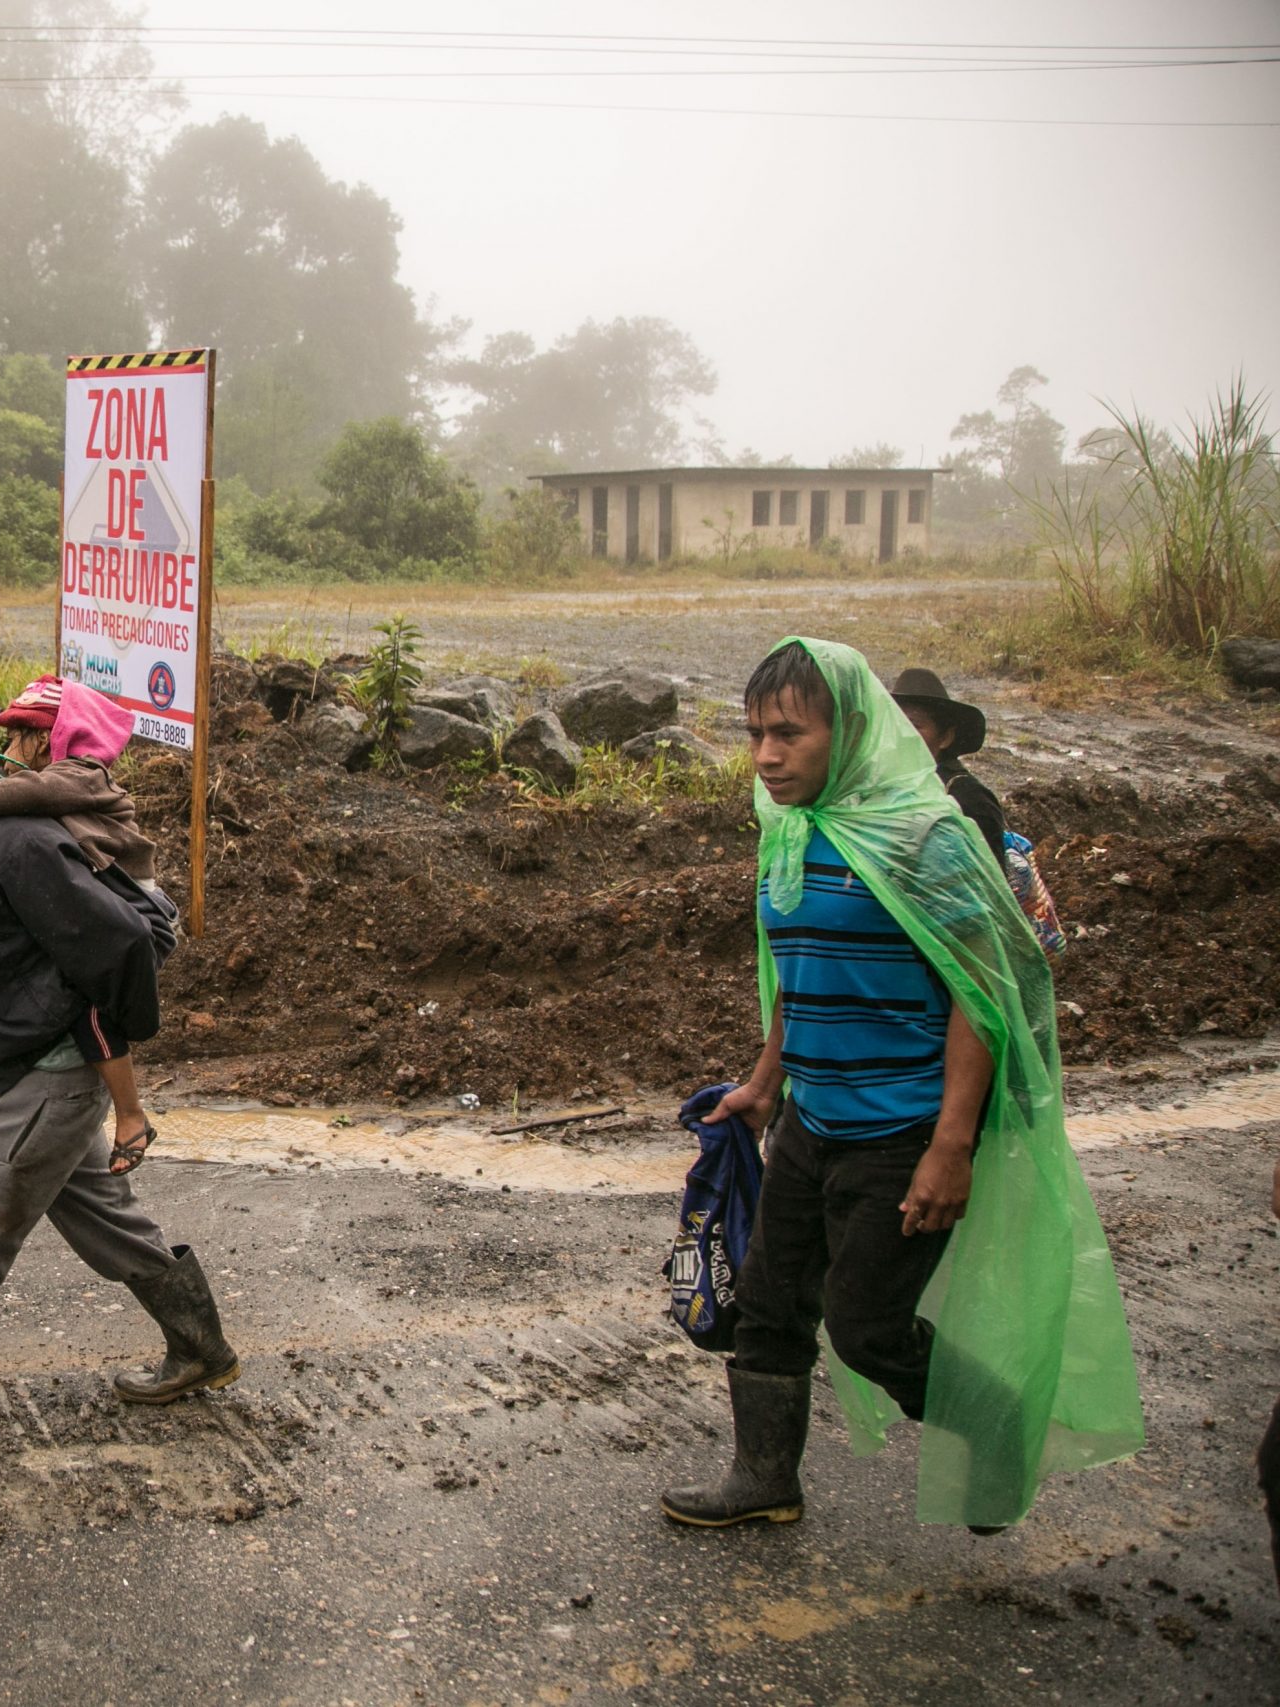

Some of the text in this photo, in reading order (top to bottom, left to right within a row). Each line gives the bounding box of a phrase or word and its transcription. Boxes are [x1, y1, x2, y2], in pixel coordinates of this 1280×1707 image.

[86, 387, 168, 461] ZONA
[107, 468, 146, 541] DE
[64, 541, 195, 612] DERRUMBE
[64, 605, 189, 652] TOMAR PRECAUCIONES
[86, 653, 118, 677] MUNI
[140, 717, 186, 745] 3079-8889
